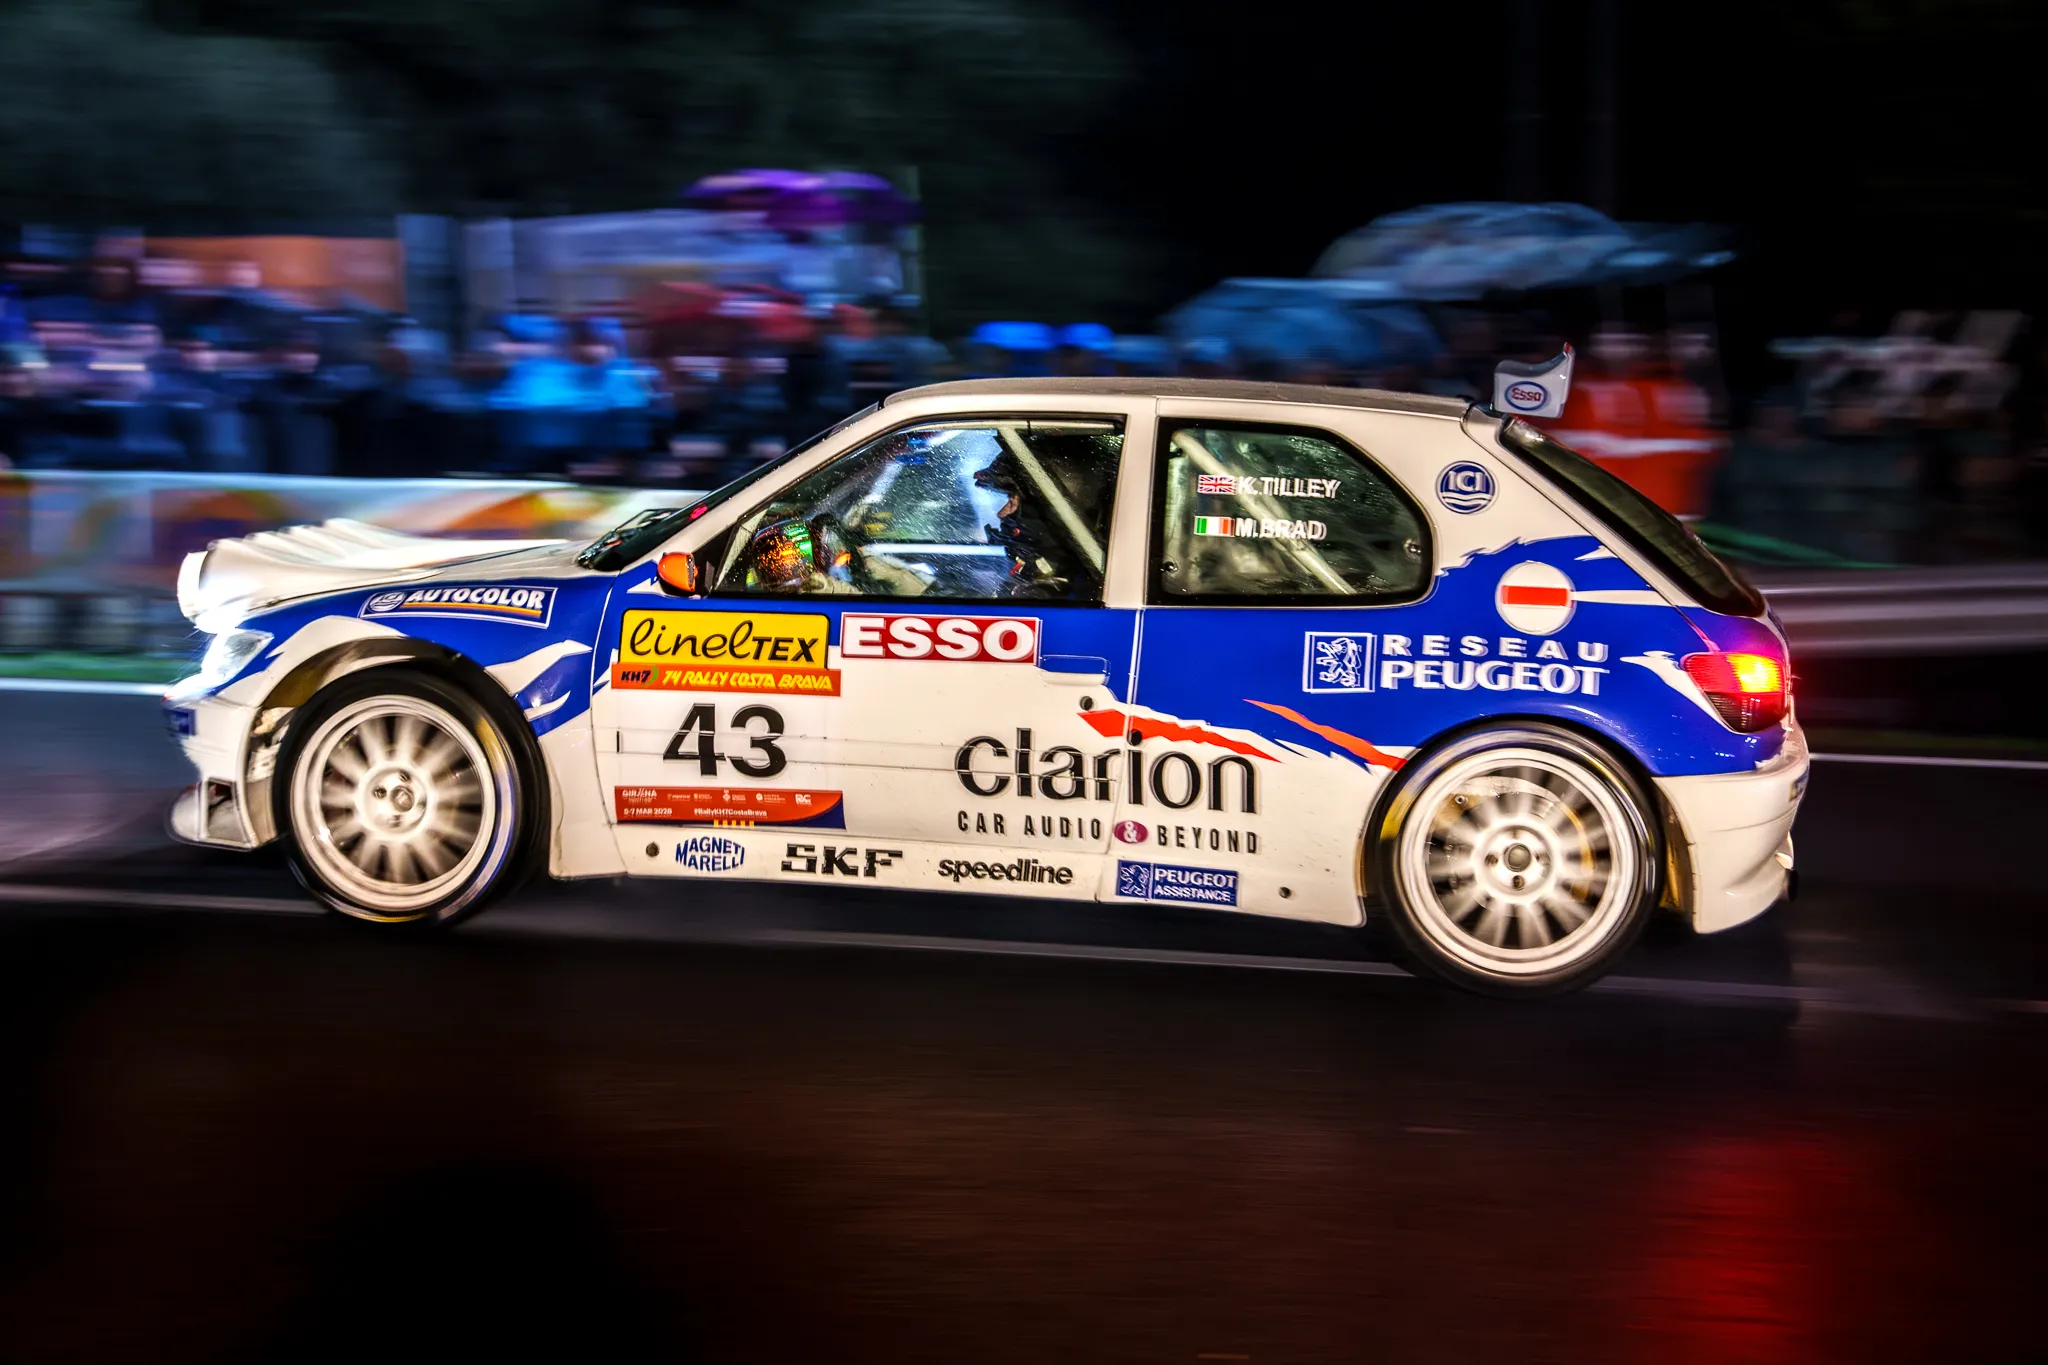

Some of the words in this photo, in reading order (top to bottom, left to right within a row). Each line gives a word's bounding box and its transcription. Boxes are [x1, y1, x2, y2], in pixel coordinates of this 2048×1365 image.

[1237, 476, 1341, 499] K.TILLEY
[1447, 470, 1487, 493] ICI
[1235, 517, 1327, 541] M.BRAD
[407, 587, 546, 609] AUTOCOLOR
[842, 616, 1036, 661] ESSO
[1381, 633, 1609, 663] RESEAU
[662, 670, 682, 686] 74
[681, 671, 729, 688] RALLY
[729, 672, 777, 689] COSTA
[778, 674, 834, 692] BRAVA
[1380, 660, 1610, 696] PEUGEOT
[662, 702, 788, 778] 43
[954, 727, 1258, 815] clarion
[957, 810, 1006, 836] CAR
[1024, 815, 1102, 841] AUDIO
[1157, 825, 1259, 855] BEYOND
[675, 836, 745, 859] MAGNETI
[675, 847, 745, 872] MARELLI
[781, 843, 903, 878] SKF
[938, 858, 1074, 885] speedline
[1154, 867, 1238, 888] PEUGEOT
[1153, 884, 1232, 903] ASSISTANCE
